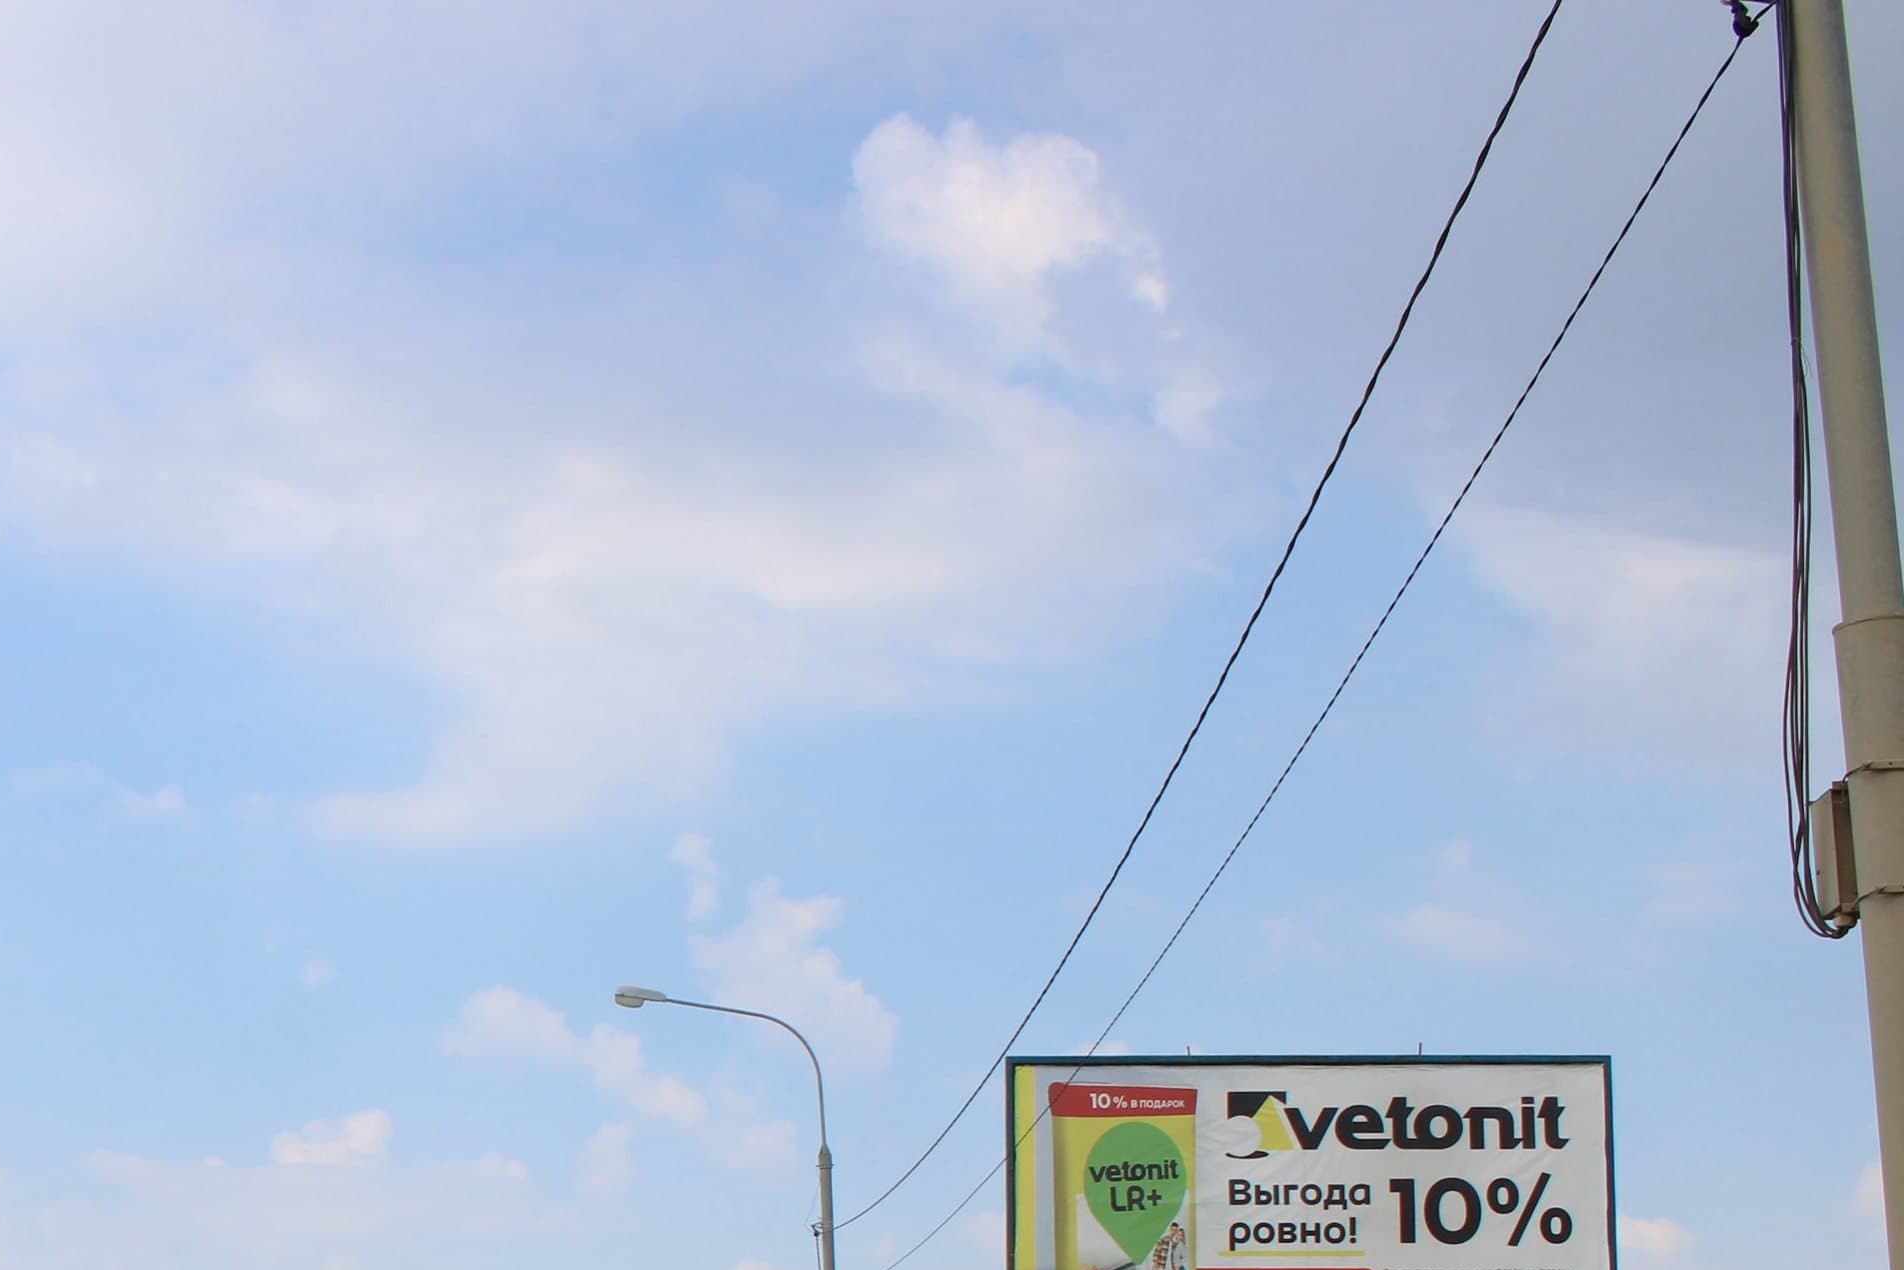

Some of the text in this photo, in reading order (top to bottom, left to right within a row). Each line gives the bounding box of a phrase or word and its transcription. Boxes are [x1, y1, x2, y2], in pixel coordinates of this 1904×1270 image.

[1130, 1099, 1138, 1108] В
[1139, 1099, 1185, 1109] ПОДАРОК
[1283, 1095, 1572, 1151] vetonit
[1088, 1159, 1180, 1183] vetonit
[1109, 1185, 1163, 1212] LR+
[1229, 1178, 1372, 1211] Выгода
[1388, 1171, 1574, 1247] 10%
[1228, 1216, 1358, 1252] ровно!
